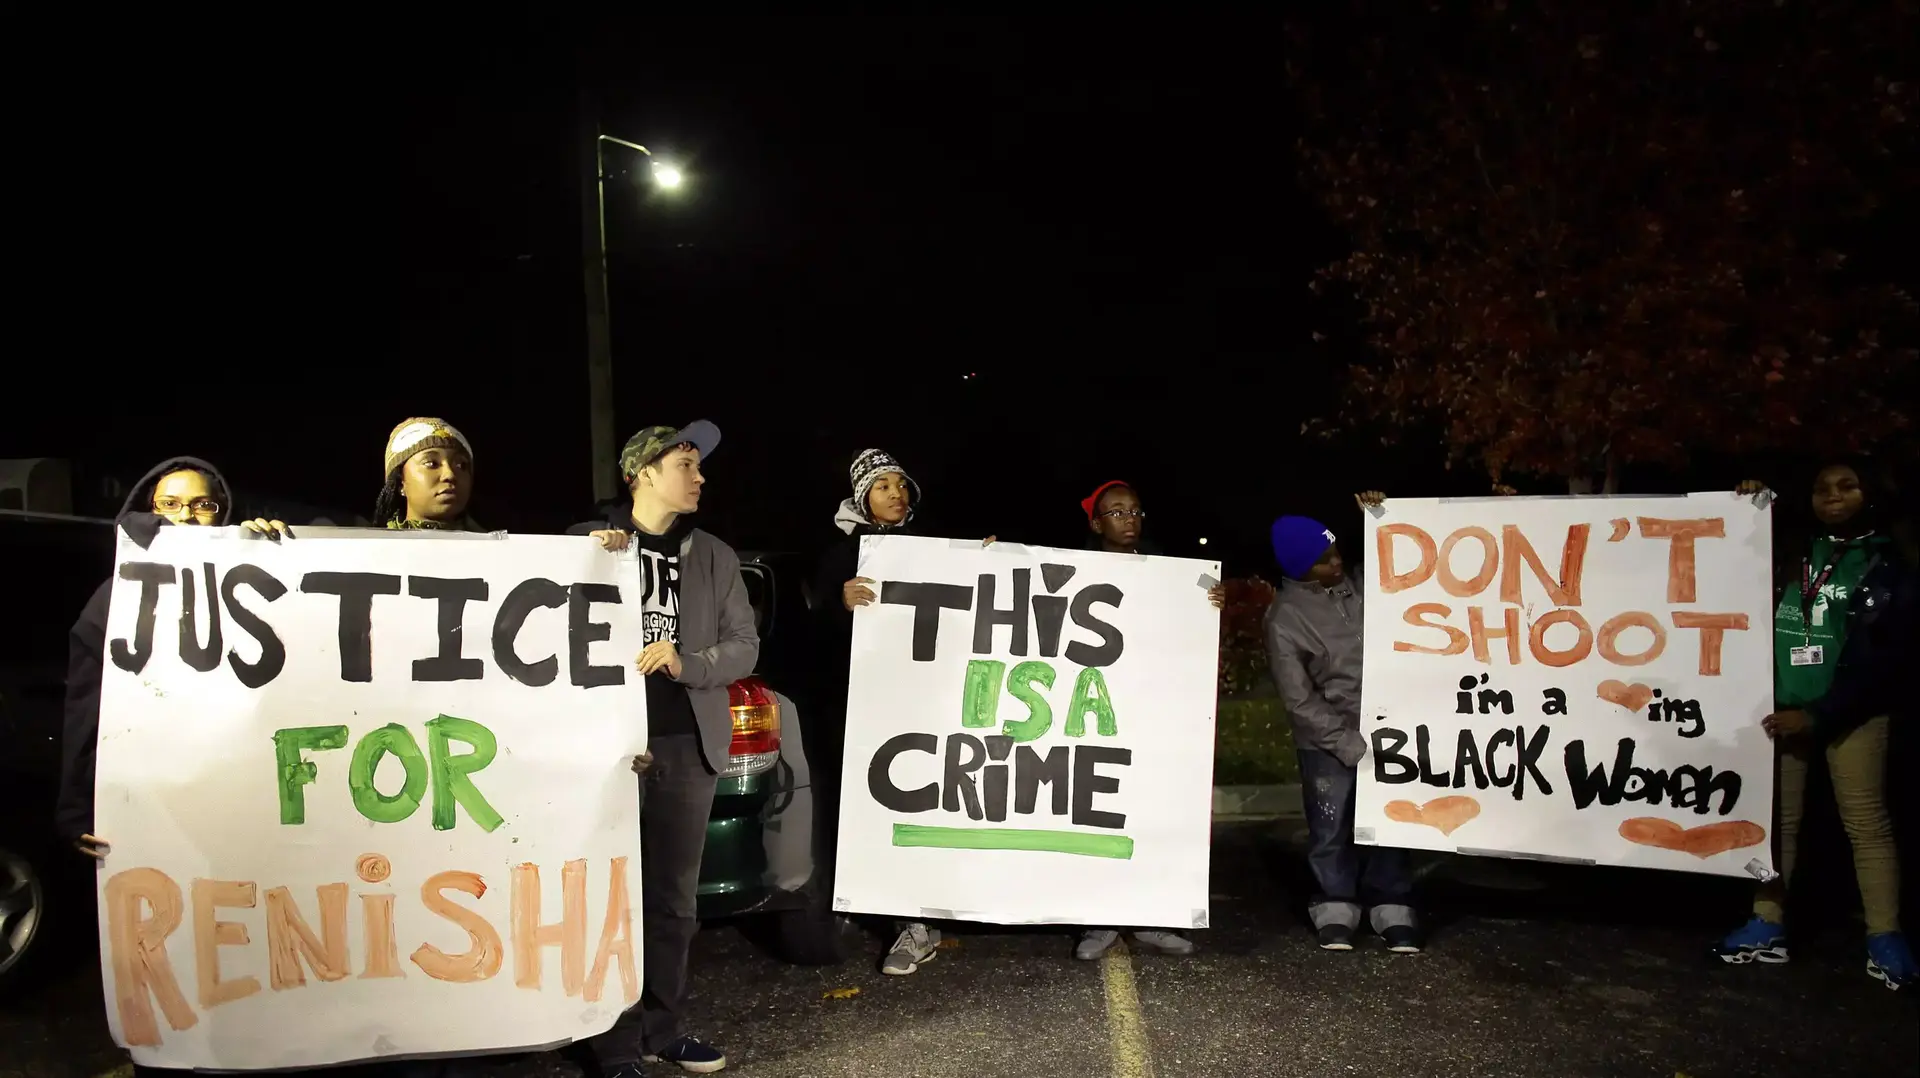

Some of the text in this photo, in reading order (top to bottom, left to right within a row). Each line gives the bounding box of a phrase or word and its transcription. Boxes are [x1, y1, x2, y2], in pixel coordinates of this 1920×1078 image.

[1377, 516, 1726, 608] DON'T
[110, 562, 626, 688] JUSTICE
[1393, 602, 1750, 676] SHOOT
[961, 660, 1118, 742] IS A
[1542, 687, 1567, 715] a
[1648, 688, 1706, 738] ing
[271, 714, 505, 833] FOR
[1371, 725, 1553, 800] BLACK
